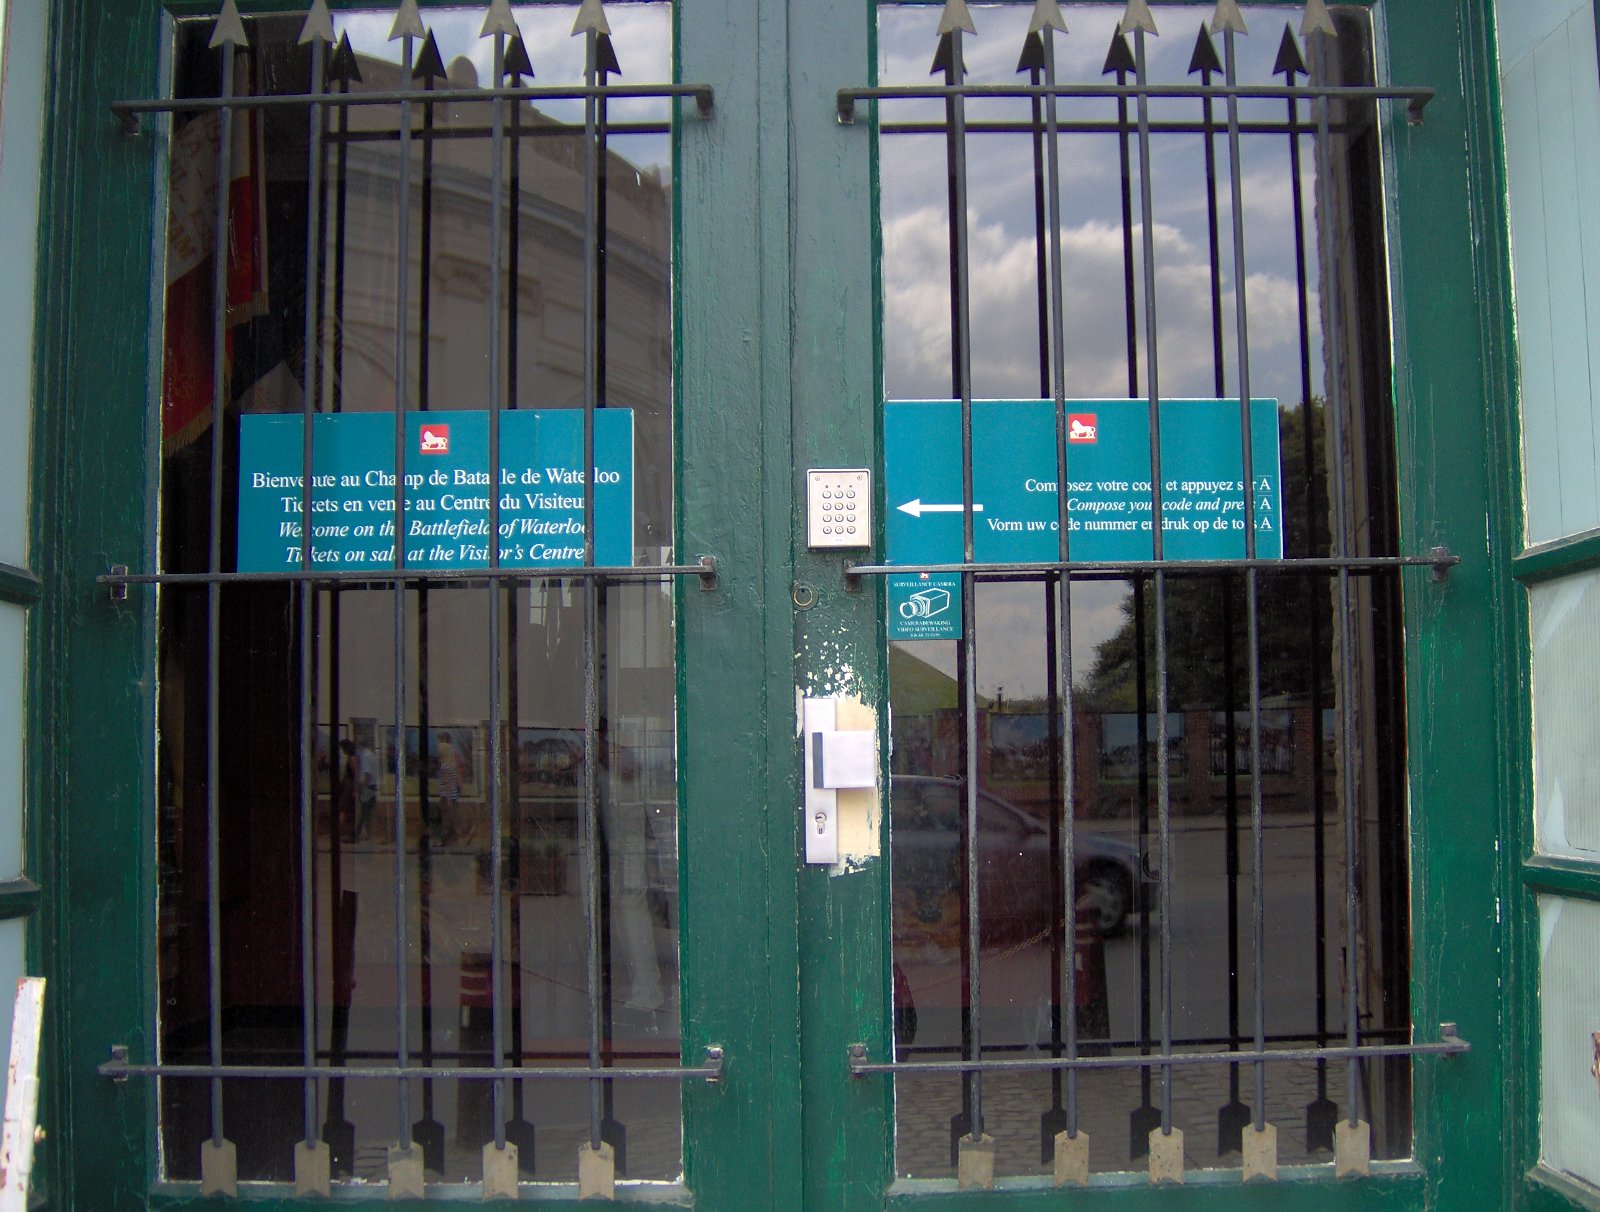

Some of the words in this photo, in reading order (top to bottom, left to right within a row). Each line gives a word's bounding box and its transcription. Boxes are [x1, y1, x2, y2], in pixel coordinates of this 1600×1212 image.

[252, 472, 336, 488] Bienvenue
[341, 475, 359, 486] au
[429, 469, 447, 485] de
[454, 468, 516, 485] Batale
[521, 468, 541, 484] de
[546, 467, 620, 484] Wateloo
[1025, 479, 1092, 494] Comosez
[1097, 480, 1128, 491] votre
[1166, 480, 1178, 491] et
[1182, 481, 1233, 494] appuyez
[1237, 481, 1257, 491] sr
[1259, 478, 1271, 490] A
[343, 499, 362, 512] en
[368, 499, 410, 512] vene
[415, 499, 435, 511] au
[500, 494, 520, 509] du
[525, 493, 585, 509] Visiteu
[1067, 498, 1125, 514] Compose
[1128, 501, 1152, 514] you
[1162, 498, 1192, 510] code
[1195, 498, 1220, 510] and
[1222, 501, 1256, 514] pre
[1260, 497, 1271, 510] A
[279, 521, 349, 537] Weome
[354, 526, 373, 537] on
[379, 520, 395, 536] th
[499, 519, 520, 539] of
[987, 518, 1023, 530] Vorm
[1027, 521, 1046, 530] uw
[1050, 518, 1080, 530] cde
[1085, 521, 1138, 530] nummer
[1162, 517, 1189, 530] druk
[1193, 520, 1209, 532] op
[1213, 517, 1228, 529] de
[1261, 517, 1272, 529] A
[286, 546, 339, 563] Tikets
[345, 550, 364, 561] on
[370, 545, 395, 562] sal
[408, 547, 424, 561] at
[429, 546, 454, 561] the
[459, 544, 523, 560] Visior's
[530, 544, 584, 560] Centre
